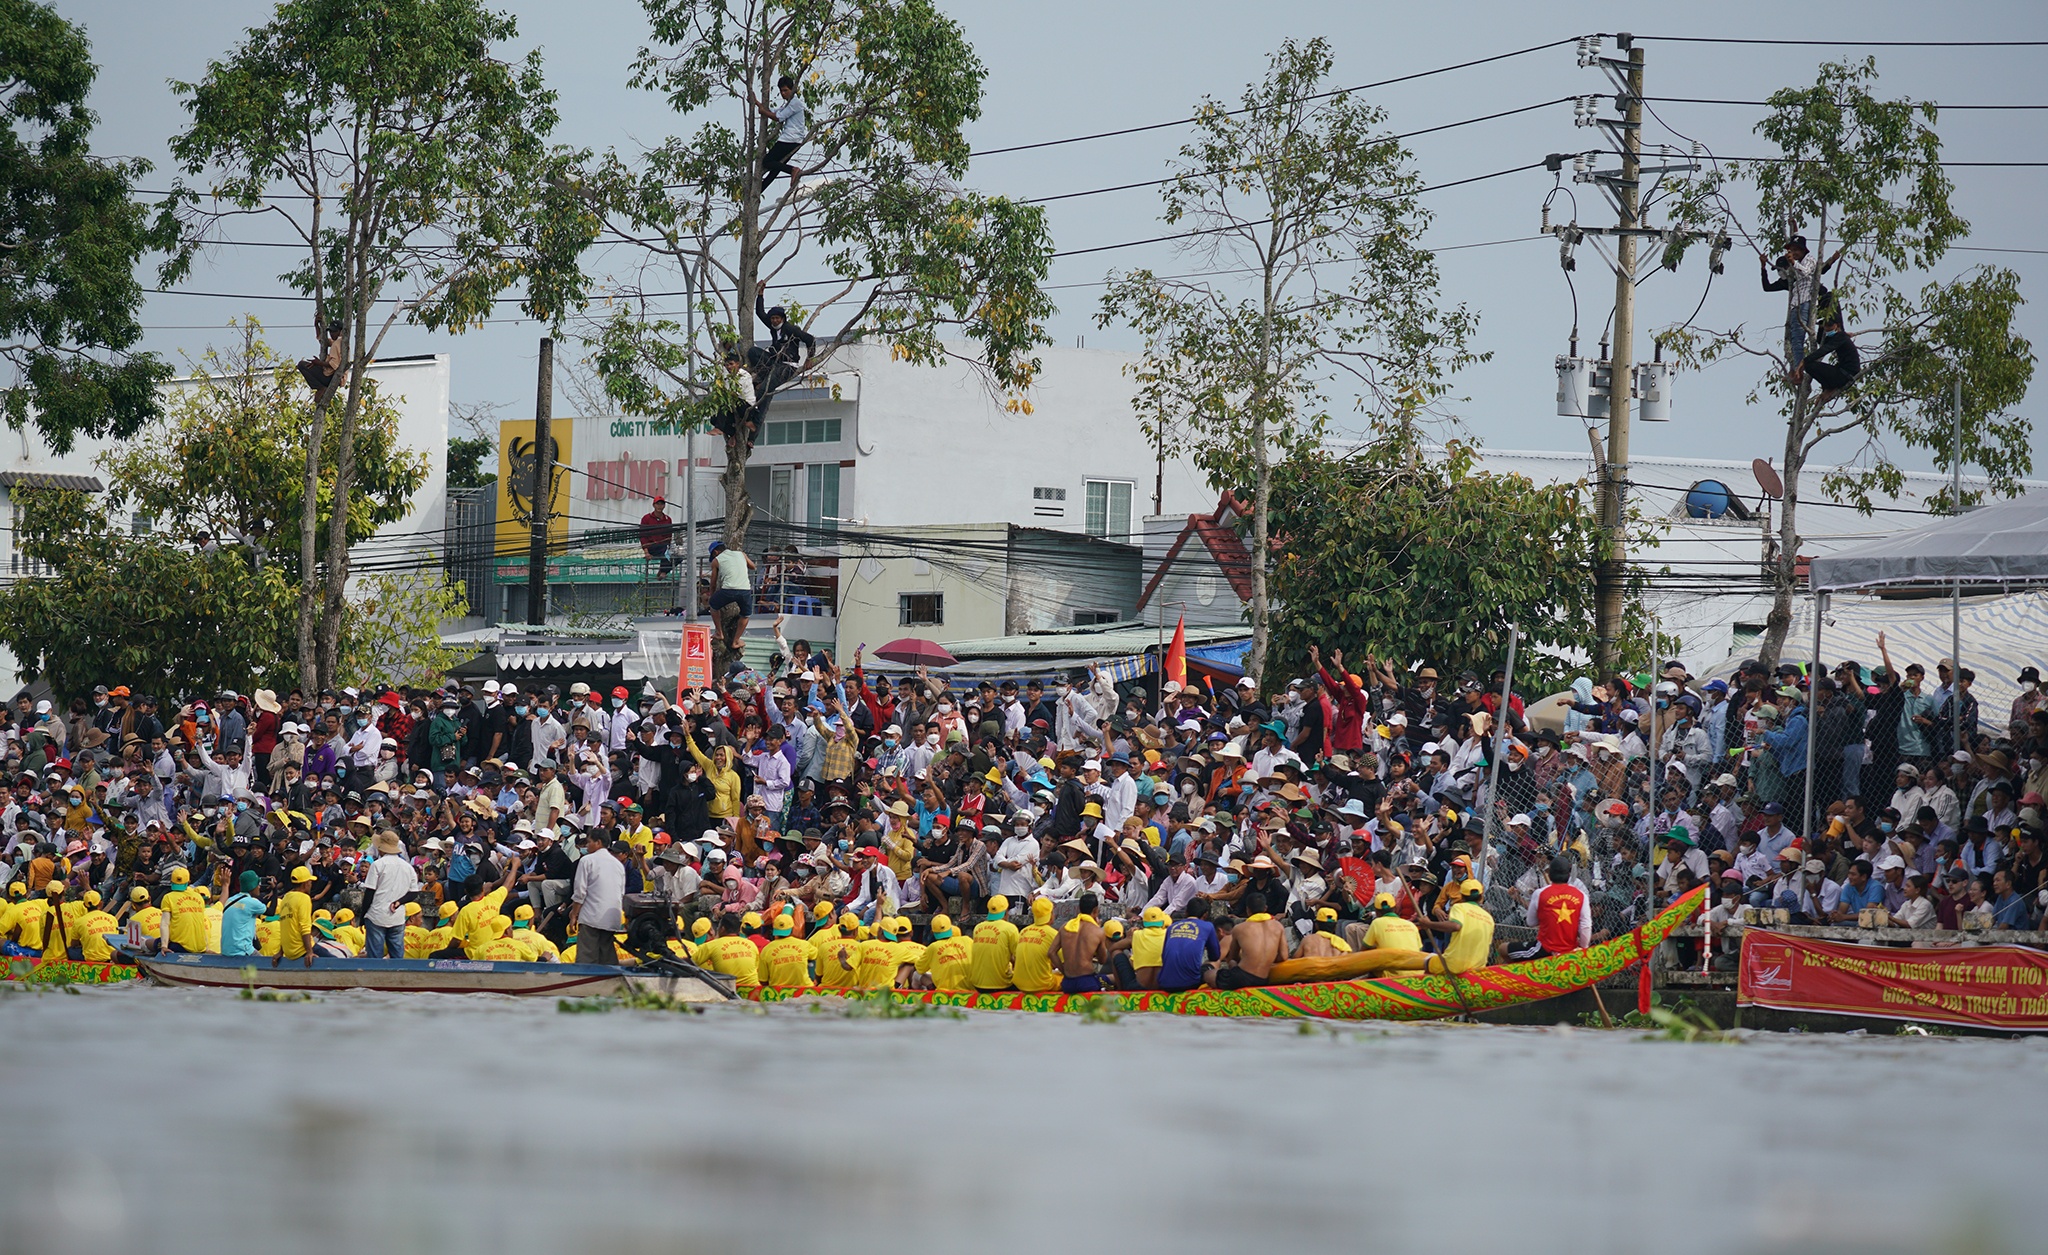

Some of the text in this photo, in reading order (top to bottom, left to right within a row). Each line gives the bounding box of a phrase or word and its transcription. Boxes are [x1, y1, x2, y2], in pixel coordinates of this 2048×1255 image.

[610, 418, 634, 438] CÔNG
[635, 421, 647, 437] TY
[586, 451, 667, 500] HƯNG
[128, 923, 140, 946] 11
[1802, 949, 1829, 968] XÂY
[1869, 961, 1897, 978] CON
[1900, 960, 1941, 981] NGƯỜI
[1944, 962, 1973, 986] VIỆT
[1975, 966, 2007, 984] NAM
[2011, 963, 2043, 985] THỜI
[1941, 994, 1963, 1013] TRỊ
[1965, 991, 2017, 1015] TRUYỀN
[2020, 992, 2048, 1016] THỐ
